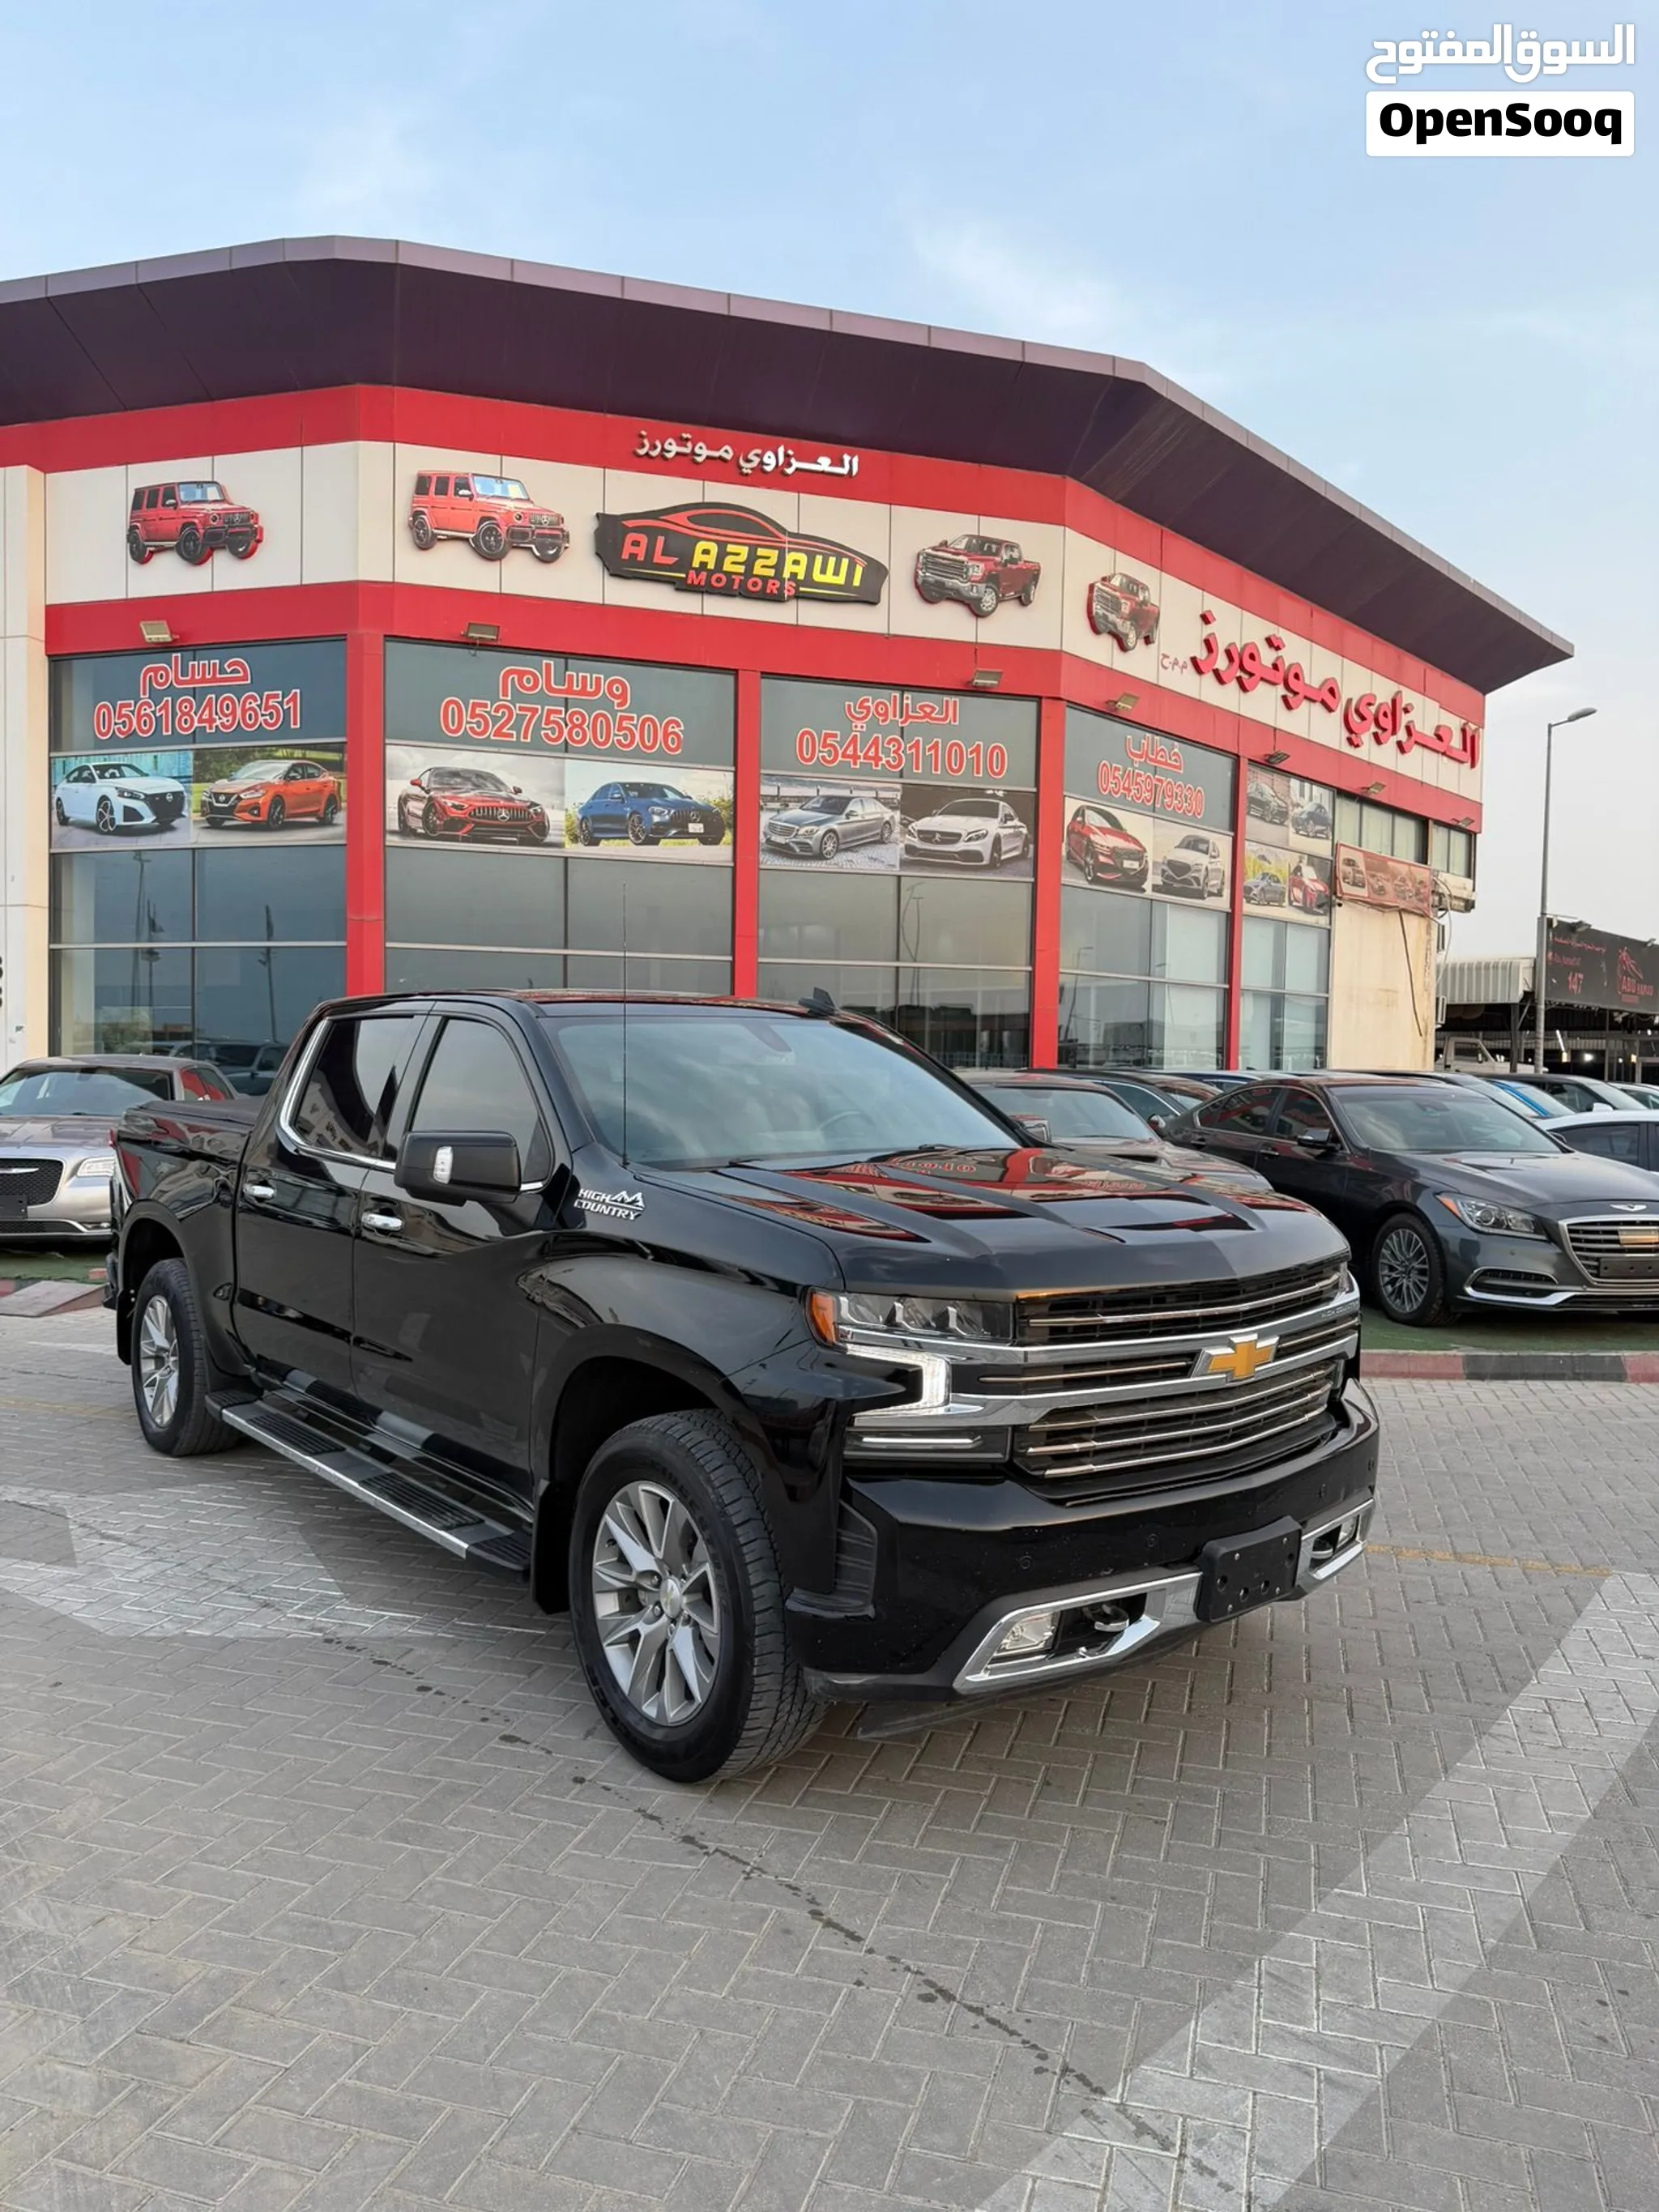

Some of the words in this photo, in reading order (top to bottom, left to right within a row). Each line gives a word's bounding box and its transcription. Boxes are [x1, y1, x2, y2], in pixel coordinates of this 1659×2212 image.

[633, 430, 734, 464] موتورز
[738, 445, 859, 477] العزاوي
[621, 532, 679, 565] AL
[692, 539, 868, 587] AZZAWI
[686, 569, 800, 597] MOTORS
[139, 653, 252, 699] حسام
[1189, 609, 1341, 713] موتورز
[499, 659, 632, 710] وسام
[93, 688, 301, 739] 0561849651
[440, 697, 684, 755] 0527580506
[845, 693, 960, 732] العزاوي
[1343, 690, 1482, 769] العزاوي
[795, 727, 1008, 779] 0544311010
[1124, 733, 1184, 774] خطاب
[1098, 760, 1205, 820] 0545979330
[1567, 971, 1584, 995] 147
[574, 1199, 642, 1221] COUNTRY
[578, 1188, 612, 1203] HIGH
